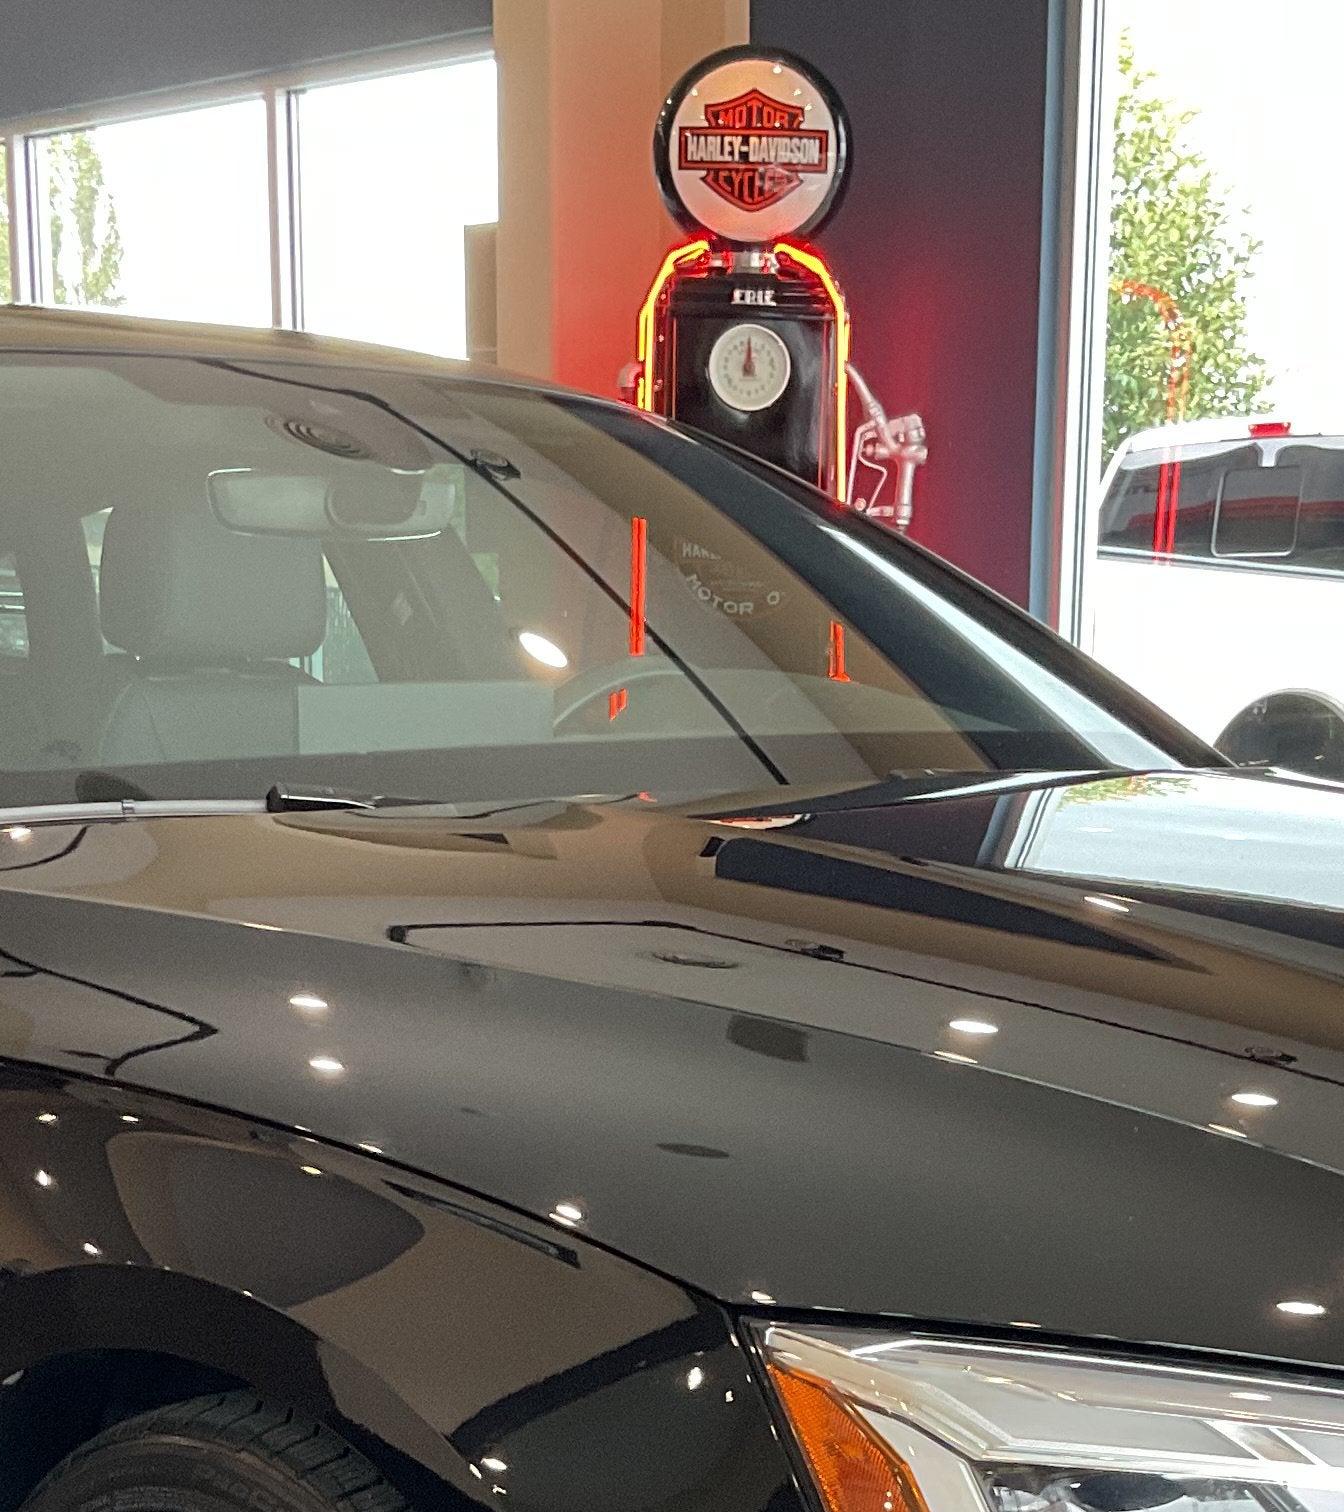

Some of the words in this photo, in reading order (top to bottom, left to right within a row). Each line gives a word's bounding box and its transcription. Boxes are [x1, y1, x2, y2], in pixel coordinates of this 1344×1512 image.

[720, 103, 788, 128] MOTOR
[687, 135, 820, 164] HARLEY-DAVIDSON
[686, 574, 754, 615] MOTOR
